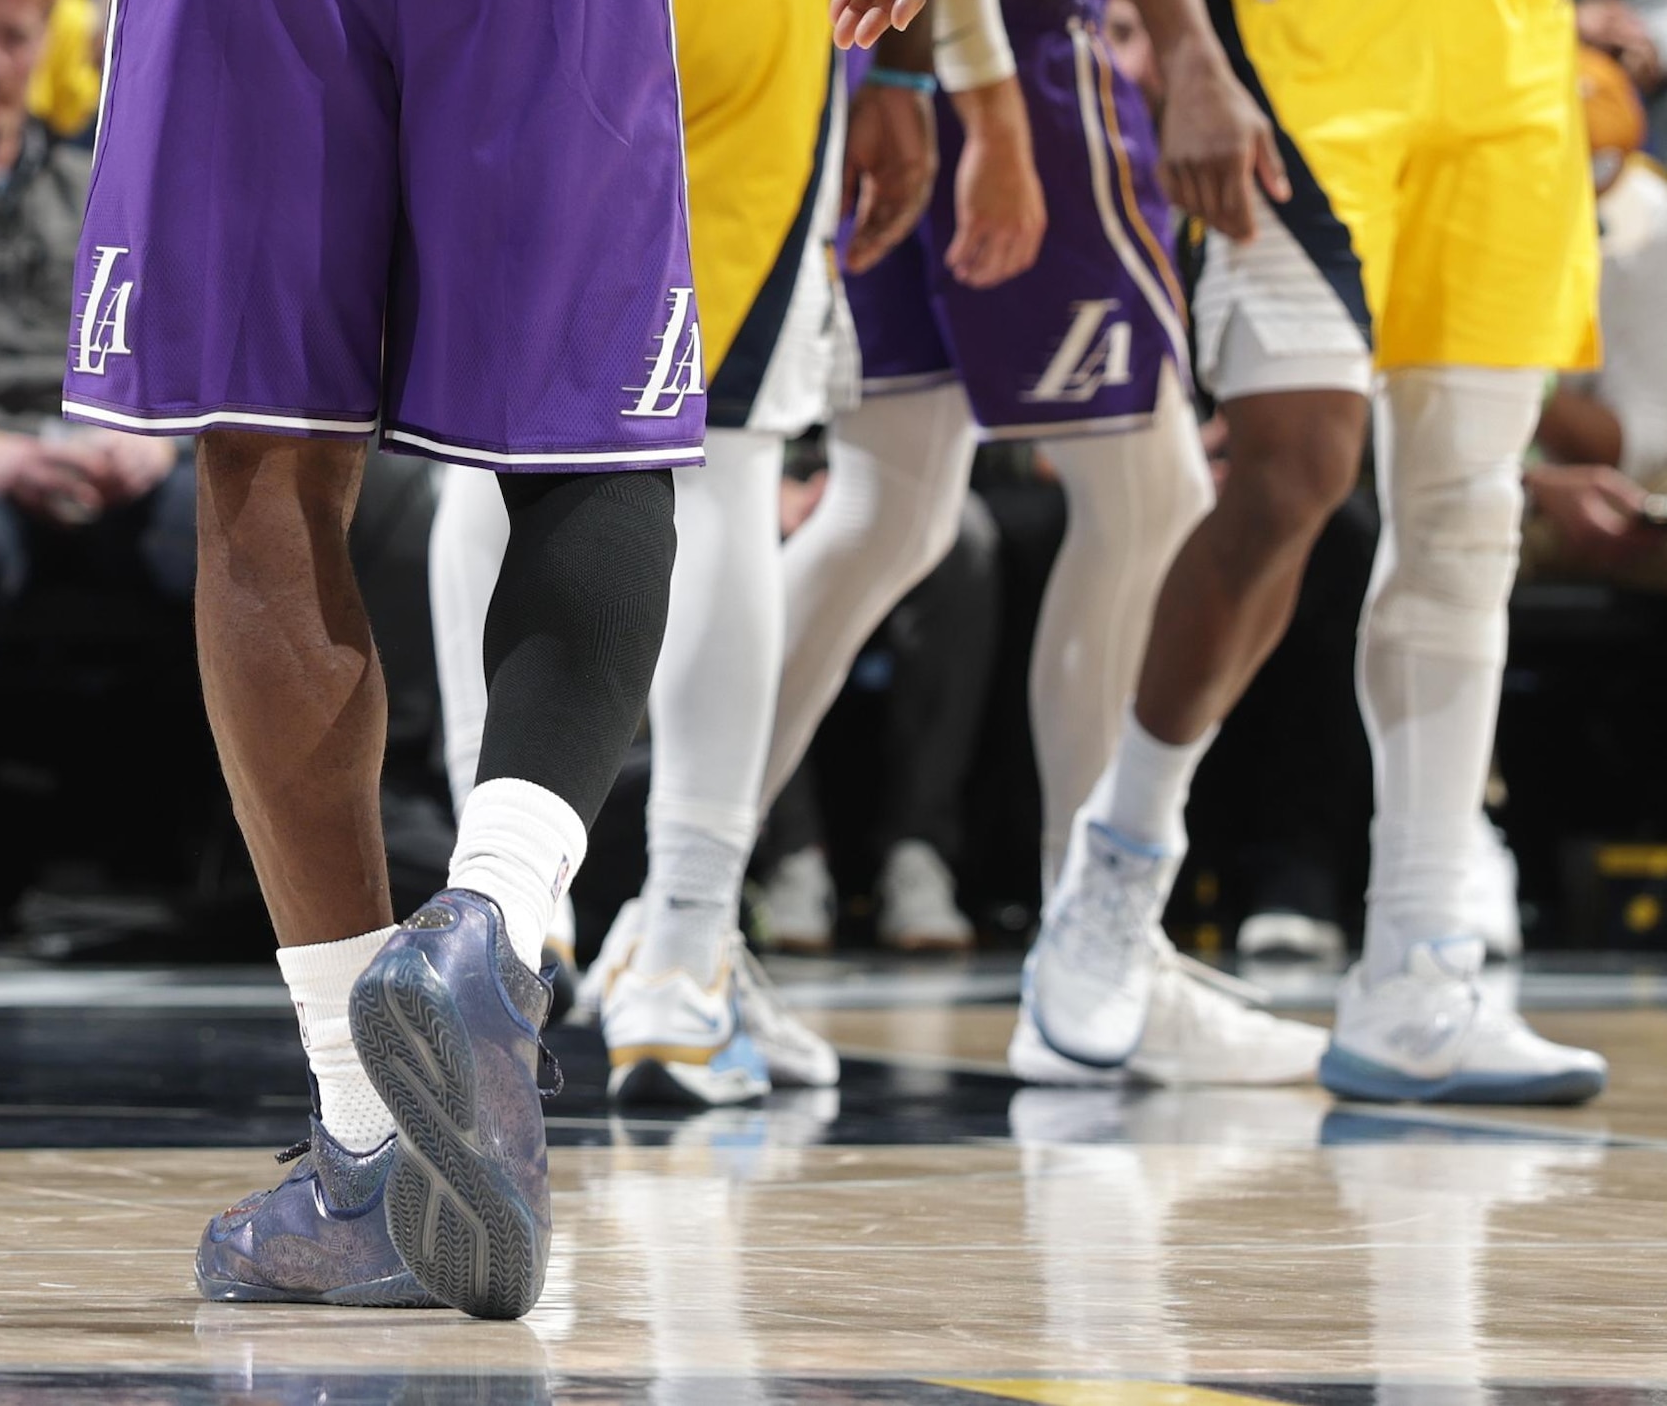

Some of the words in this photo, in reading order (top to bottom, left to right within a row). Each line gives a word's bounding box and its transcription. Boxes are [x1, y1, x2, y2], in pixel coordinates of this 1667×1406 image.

[71, 245, 134, 375] LA
[620, 287, 705, 418] LA
[1018, 297, 1134, 404] LA
